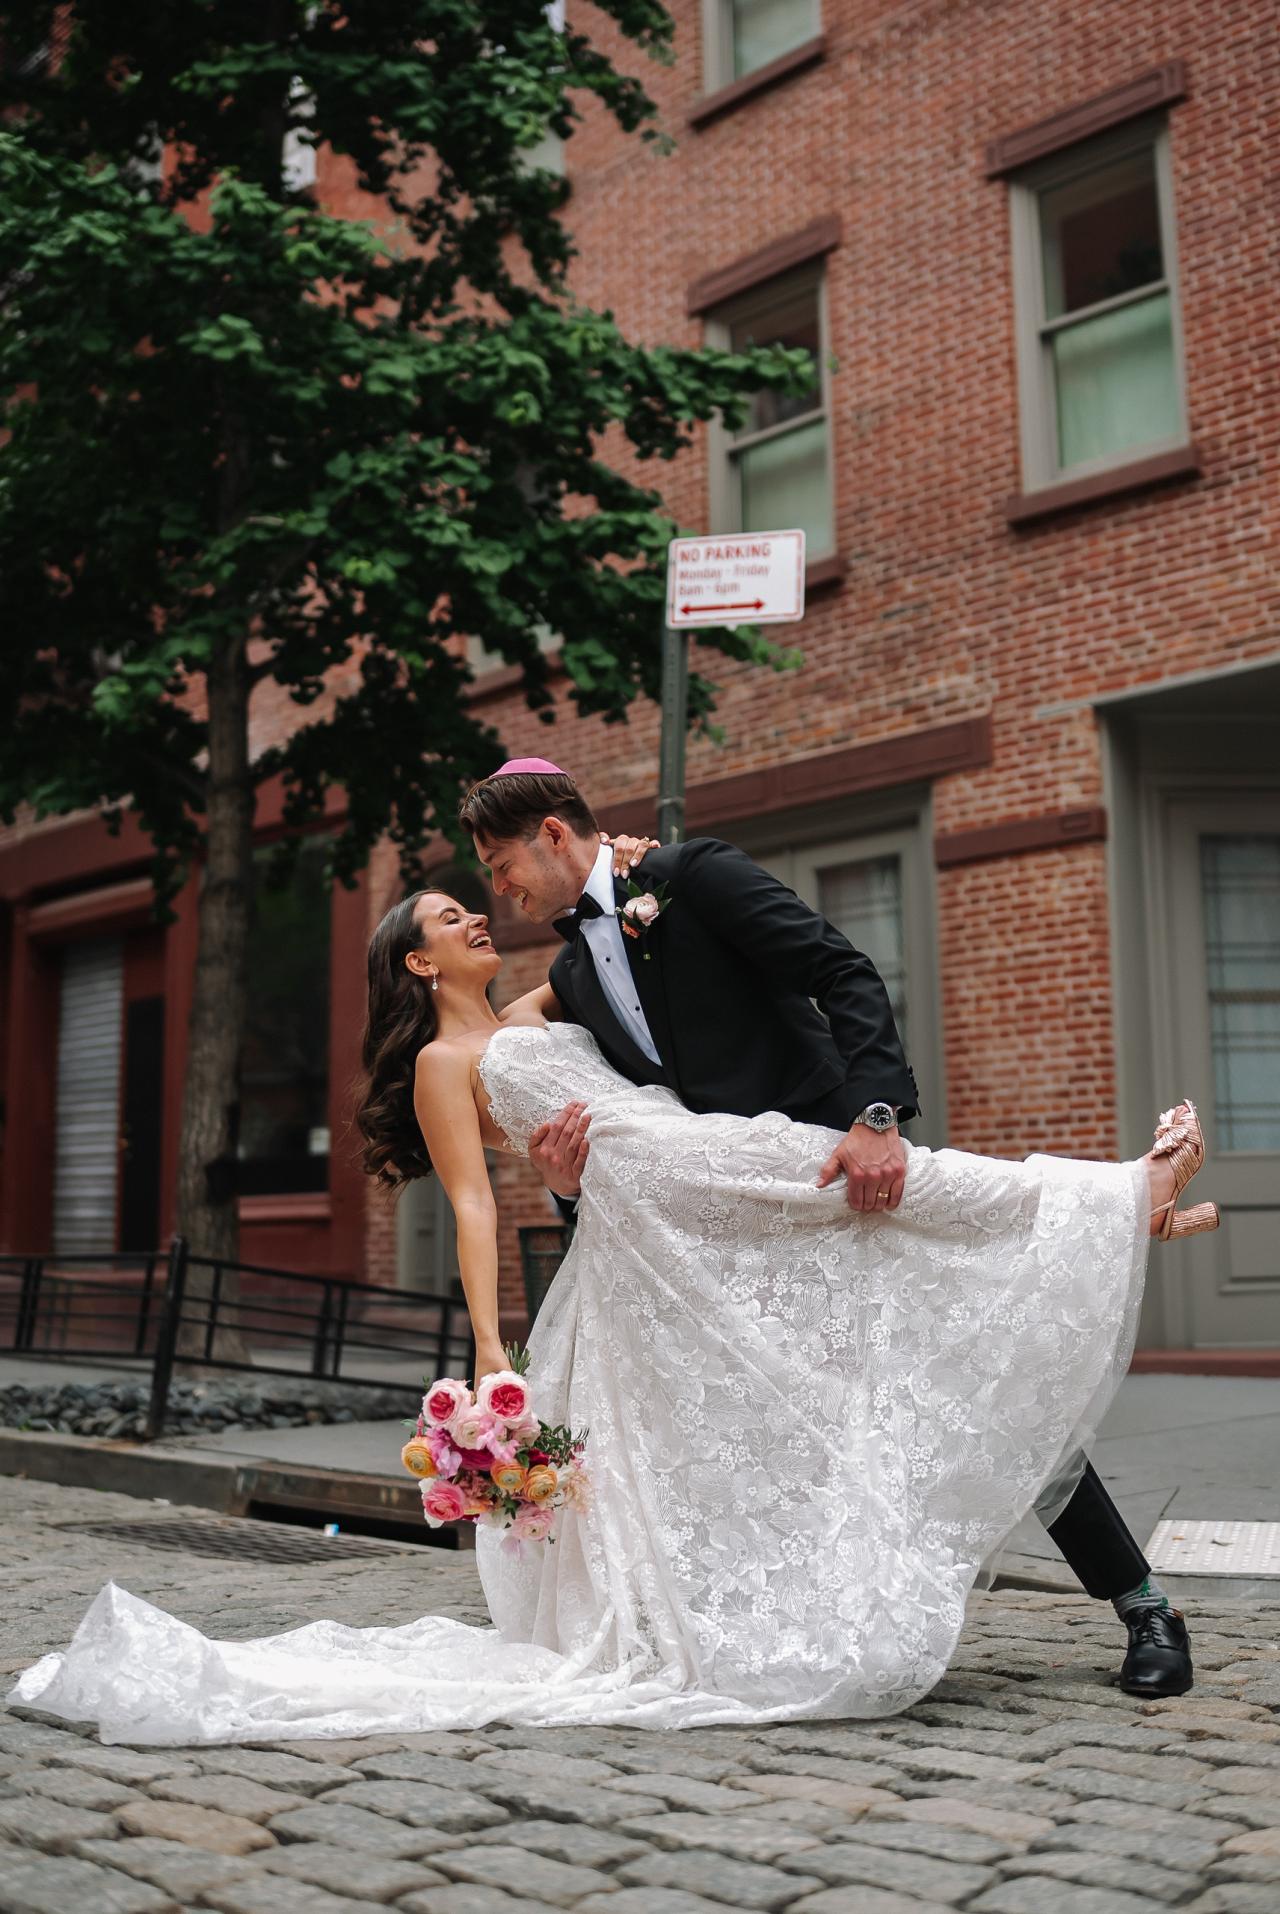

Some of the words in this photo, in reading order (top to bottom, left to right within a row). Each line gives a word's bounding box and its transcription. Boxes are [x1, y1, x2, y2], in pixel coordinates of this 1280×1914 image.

[680, 548, 700, 562] NO
[705, 543, 771, 560] PARKING
[679, 567, 722, 581] Monday
[734, 564, 770, 578] Friday
